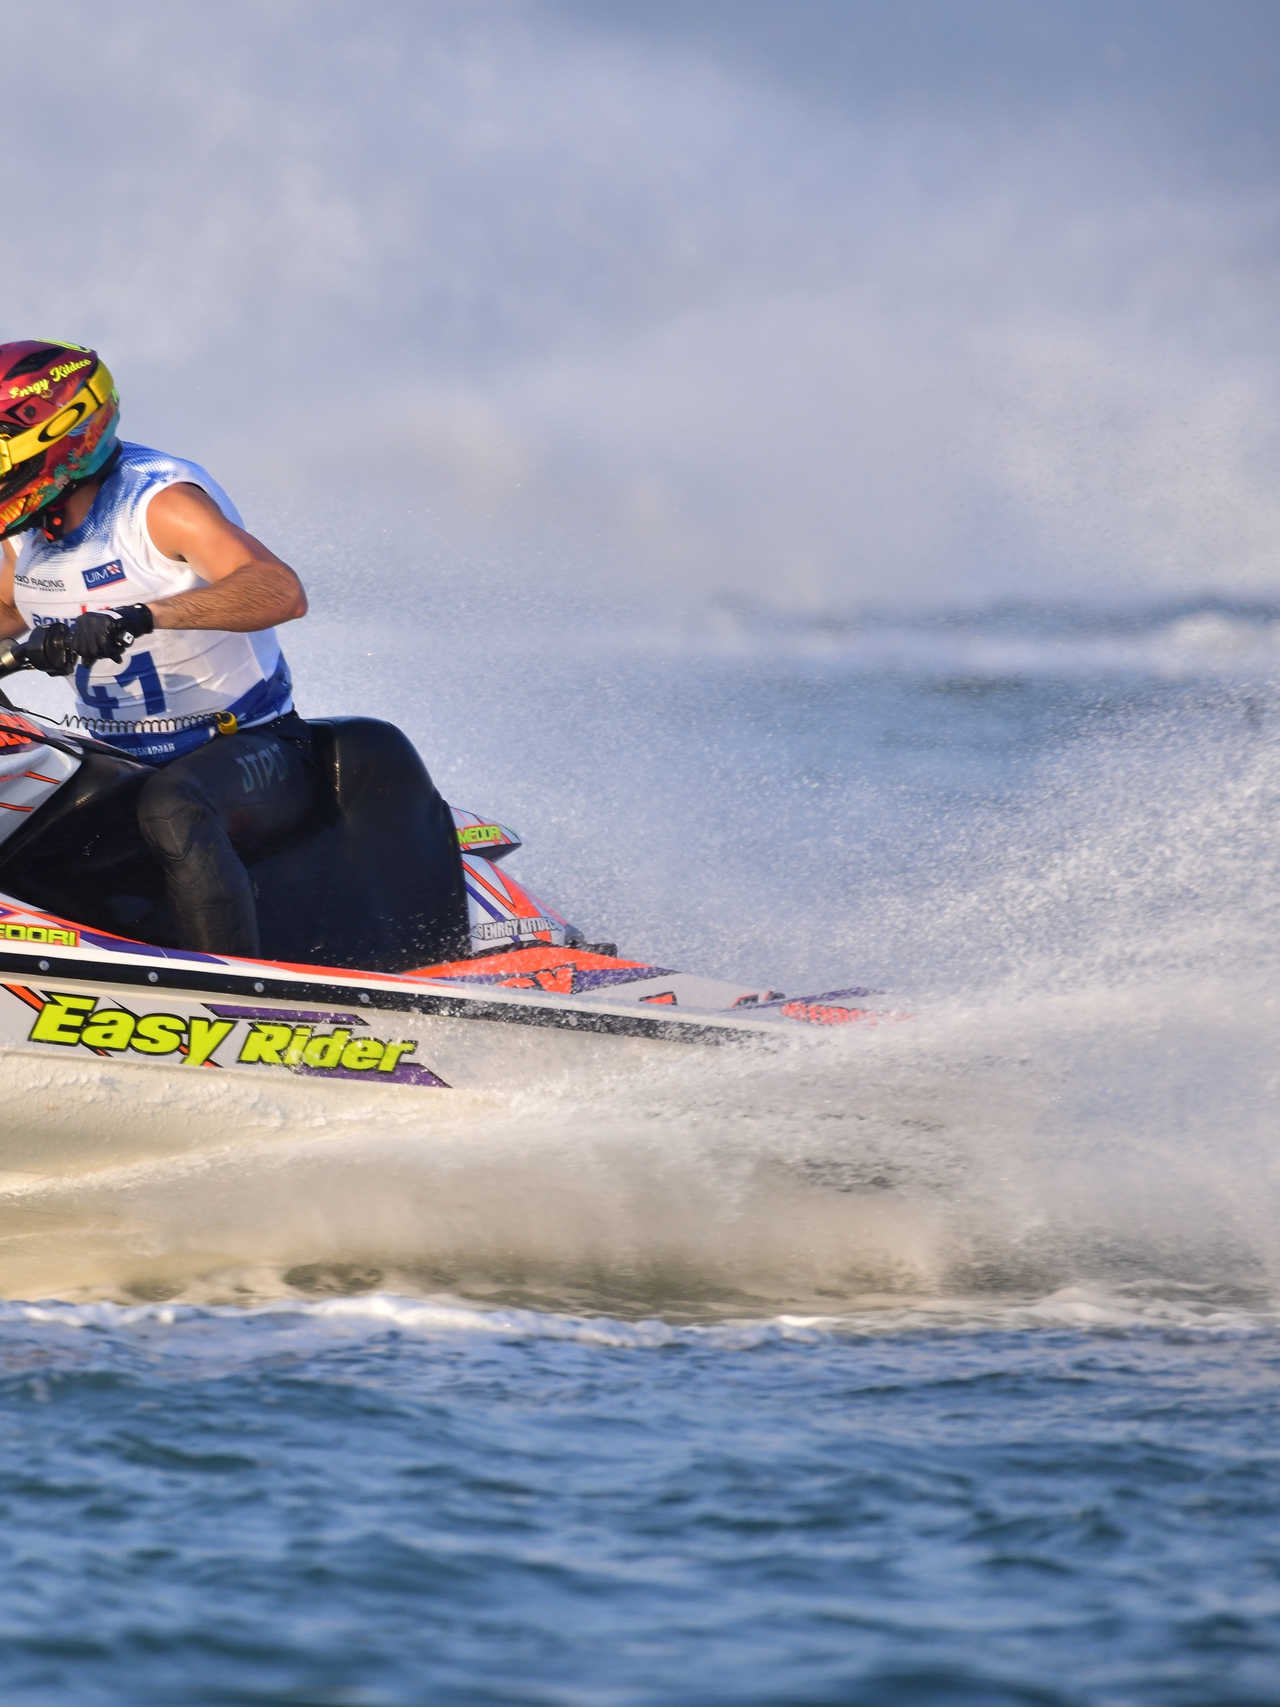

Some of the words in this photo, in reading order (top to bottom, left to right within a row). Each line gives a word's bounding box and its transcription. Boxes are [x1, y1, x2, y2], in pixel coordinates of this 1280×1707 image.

[30, 577, 65, 588] RACING
[85, 568, 109, 584] UIM
[74, 650, 167, 721] 41
[483, 919, 520, 940] ENRGY
[27, 989, 236, 1066] Easy
[237, 1021, 419, 1074] Rider
